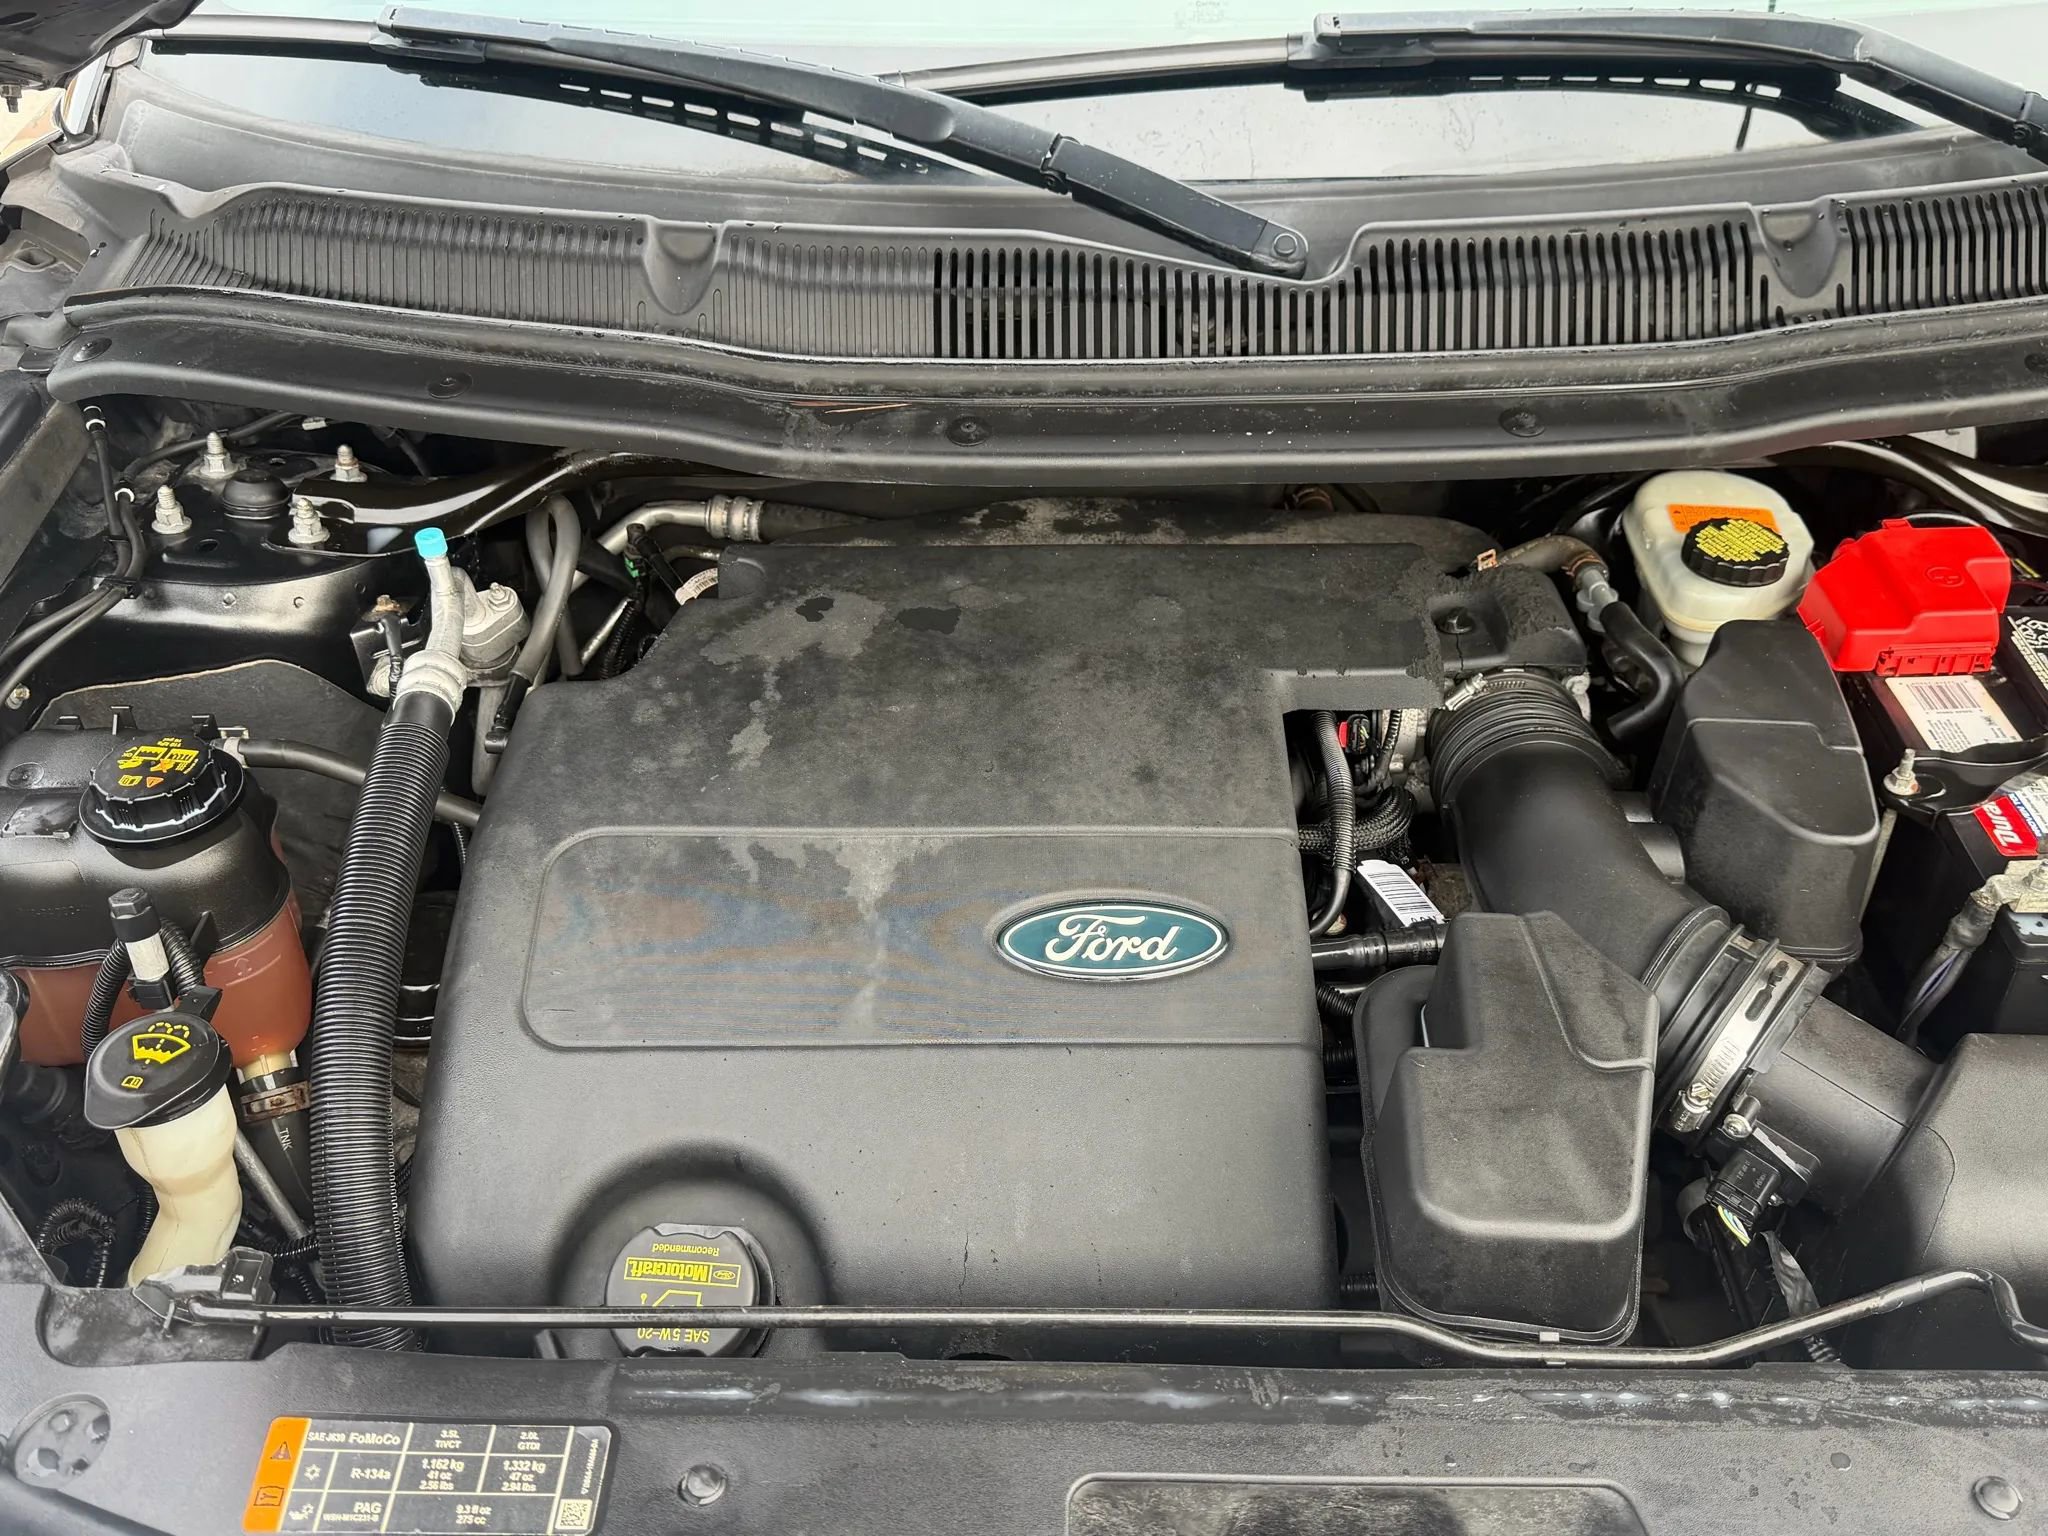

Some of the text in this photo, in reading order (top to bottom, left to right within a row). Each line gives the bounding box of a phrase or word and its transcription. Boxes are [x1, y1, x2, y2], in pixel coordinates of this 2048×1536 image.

[1982, 801, 2023, 847] Dura
[1045, 914, 1181, 962] Ford
[280, 1127, 294, 1152] TNK
[652, 1243, 720, 1257] Recommended
[628, 1260, 709, 1282] Motorcraft
[684, 1329, 710, 1344] SAE
[308, 1431, 401, 1445] SAE J639 FoMoCo
[450, 1459, 465, 1473] kg
[531, 1460, 547, 1474] kg
[350, 1467, 392, 1480] R-134a
[439, 1472, 453, 1480] oz
[508, 1472, 535, 1481] 47 oz
[439, 1480, 455, 1491] lbs
[521, 1482, 537, 1492] lbs
[353, 1501, 383, 1514] PAG
[479, 1506, 493, 1516] oz
[474, 1516, 487, 1526] cc
